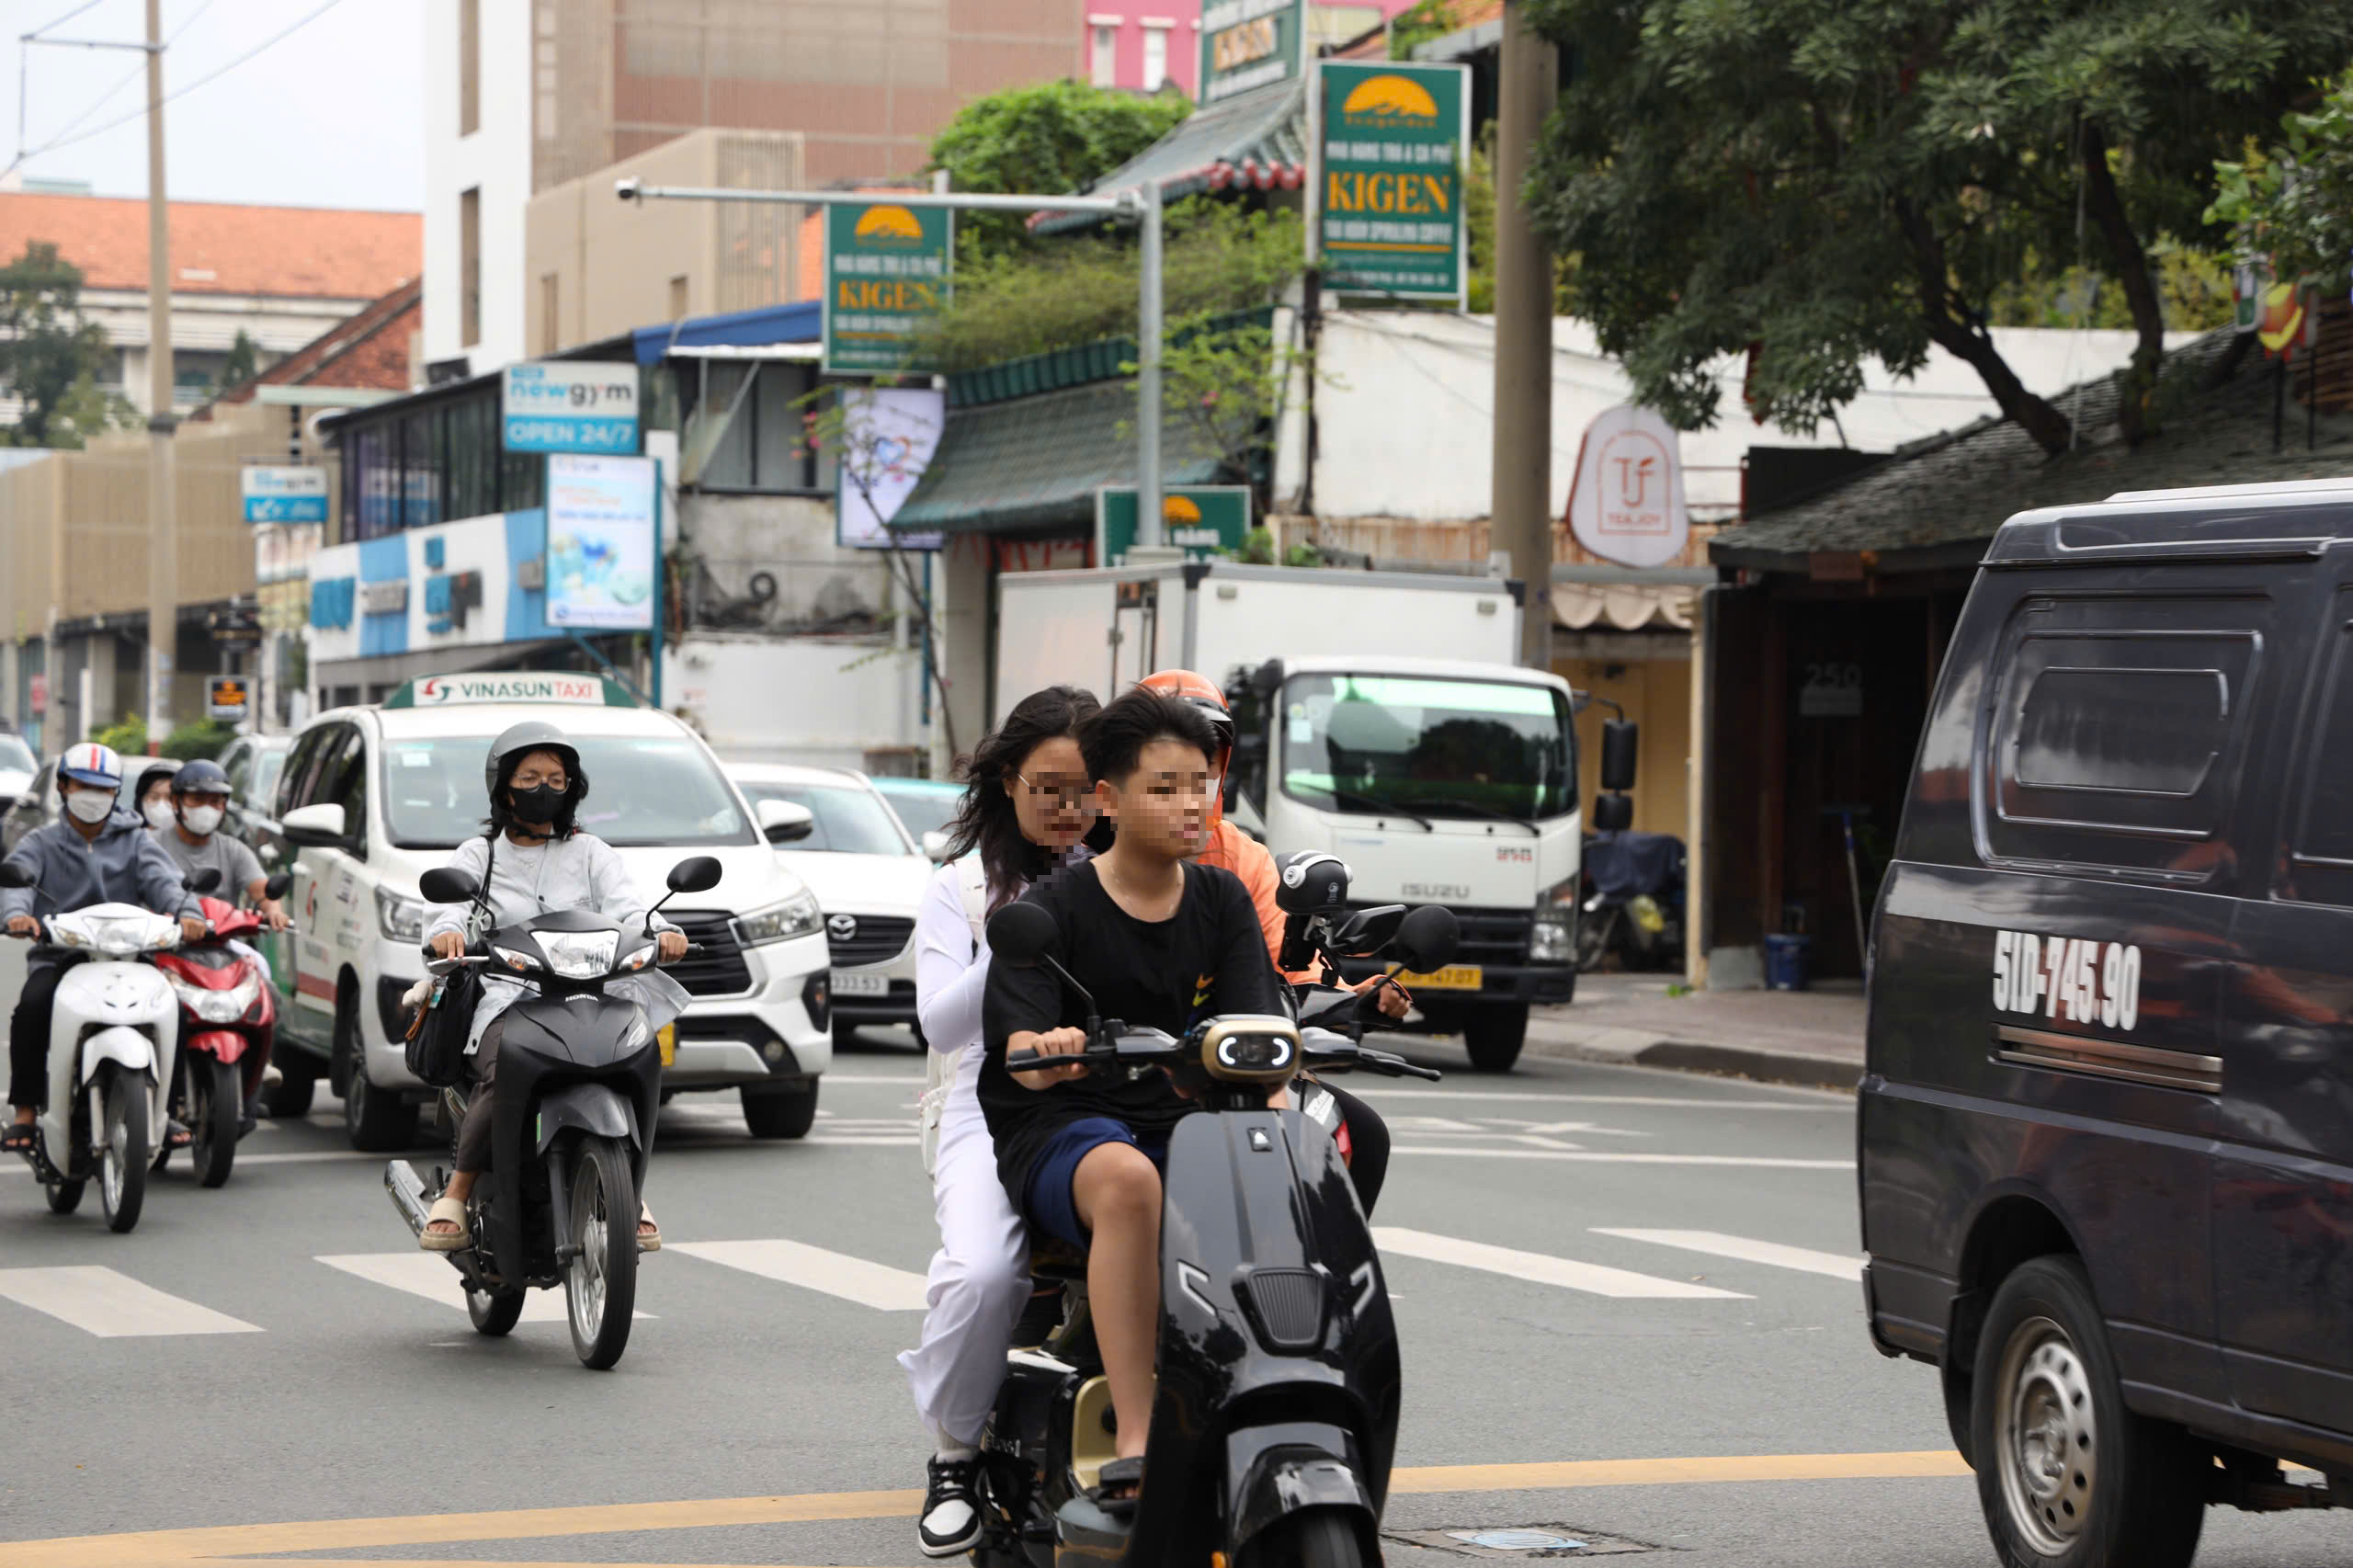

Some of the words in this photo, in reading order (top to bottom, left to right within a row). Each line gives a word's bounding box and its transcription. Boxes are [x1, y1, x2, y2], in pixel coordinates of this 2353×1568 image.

[1326, 171, 1452, 214] KIGEN
[508, 422, 574, 444] OPEN
[1401, 882, 1471, 900] ISUZU
[565, 994, 598, 1003] HONDA
